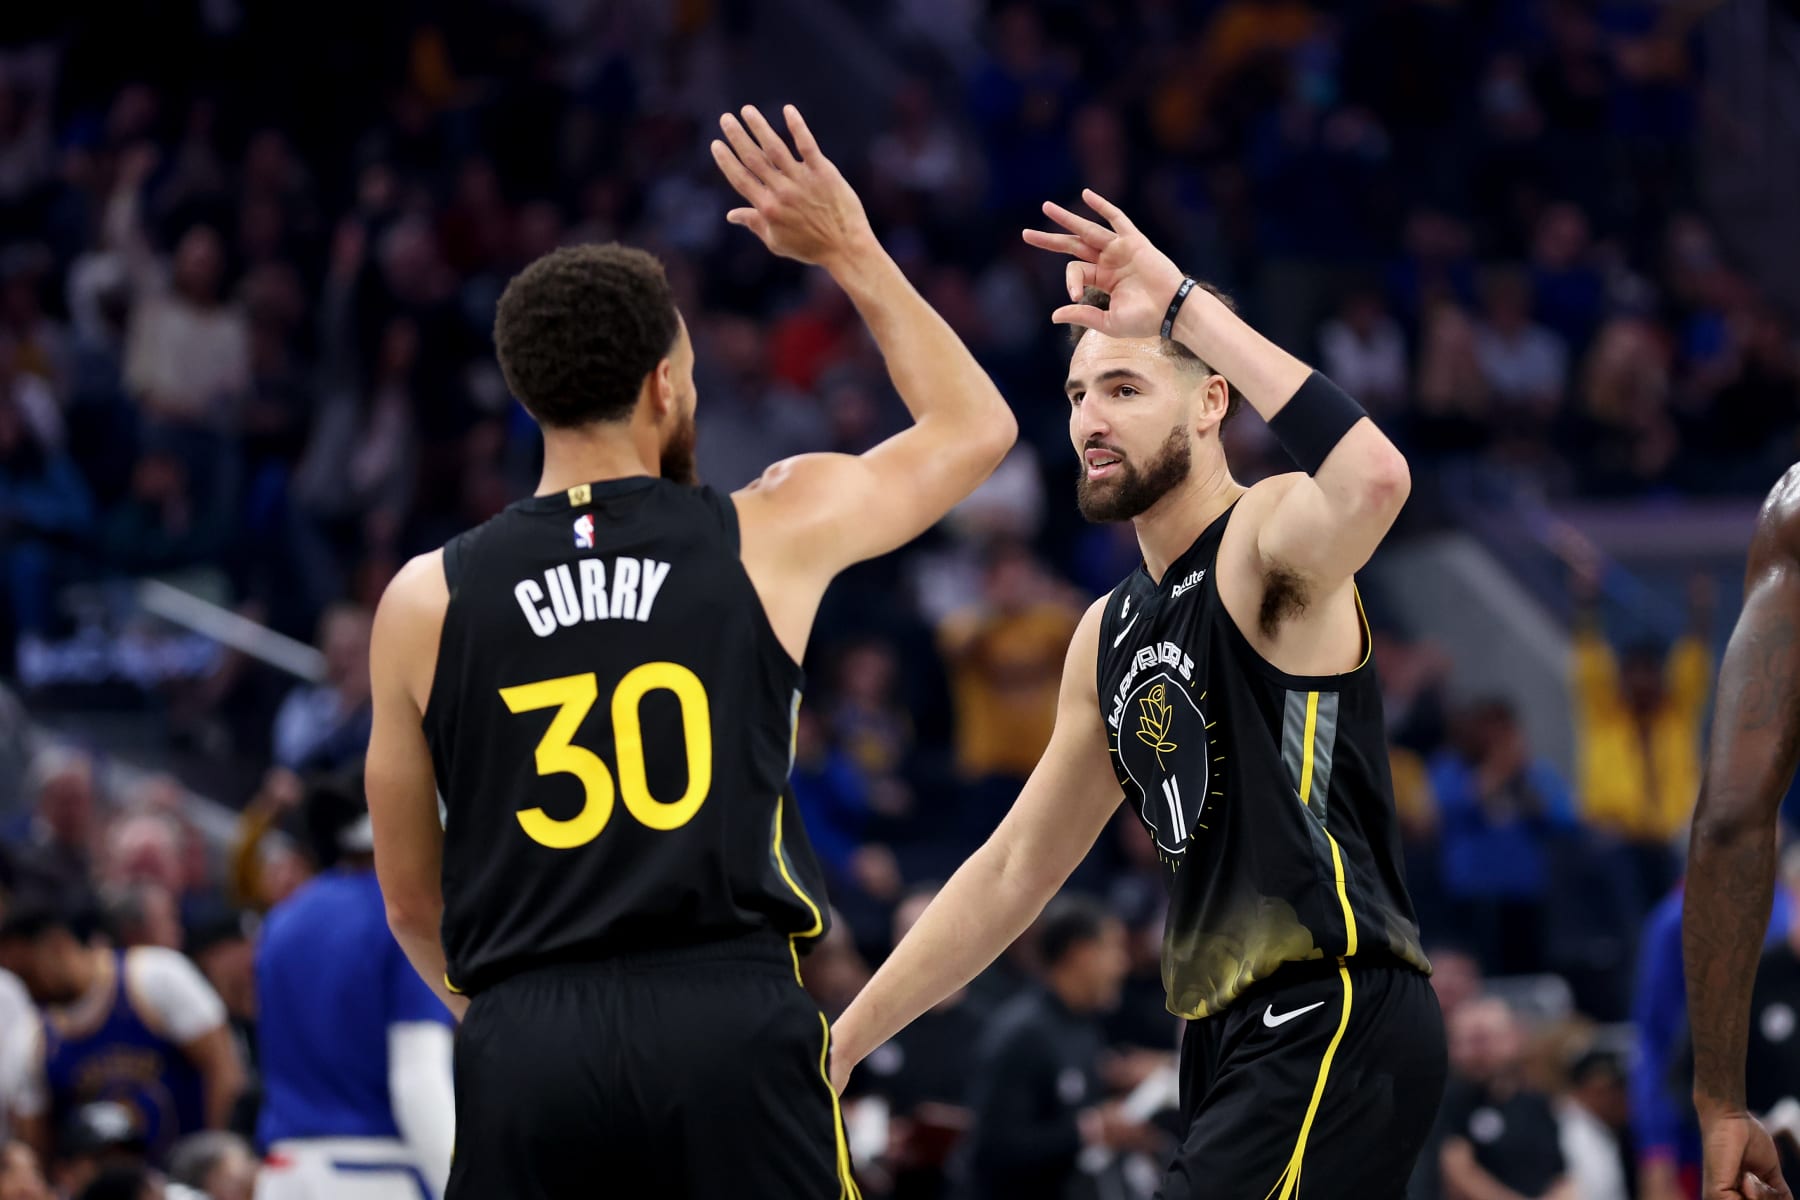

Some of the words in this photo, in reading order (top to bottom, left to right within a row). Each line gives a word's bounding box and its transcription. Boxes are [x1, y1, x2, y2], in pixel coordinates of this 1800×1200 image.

[514, 556, 671, 637] CURRY
[1108, 641, 1195, 729] WARRIORS
[498, 661, 712, 849] 30
[1162, 774, 1187, 844] 11
